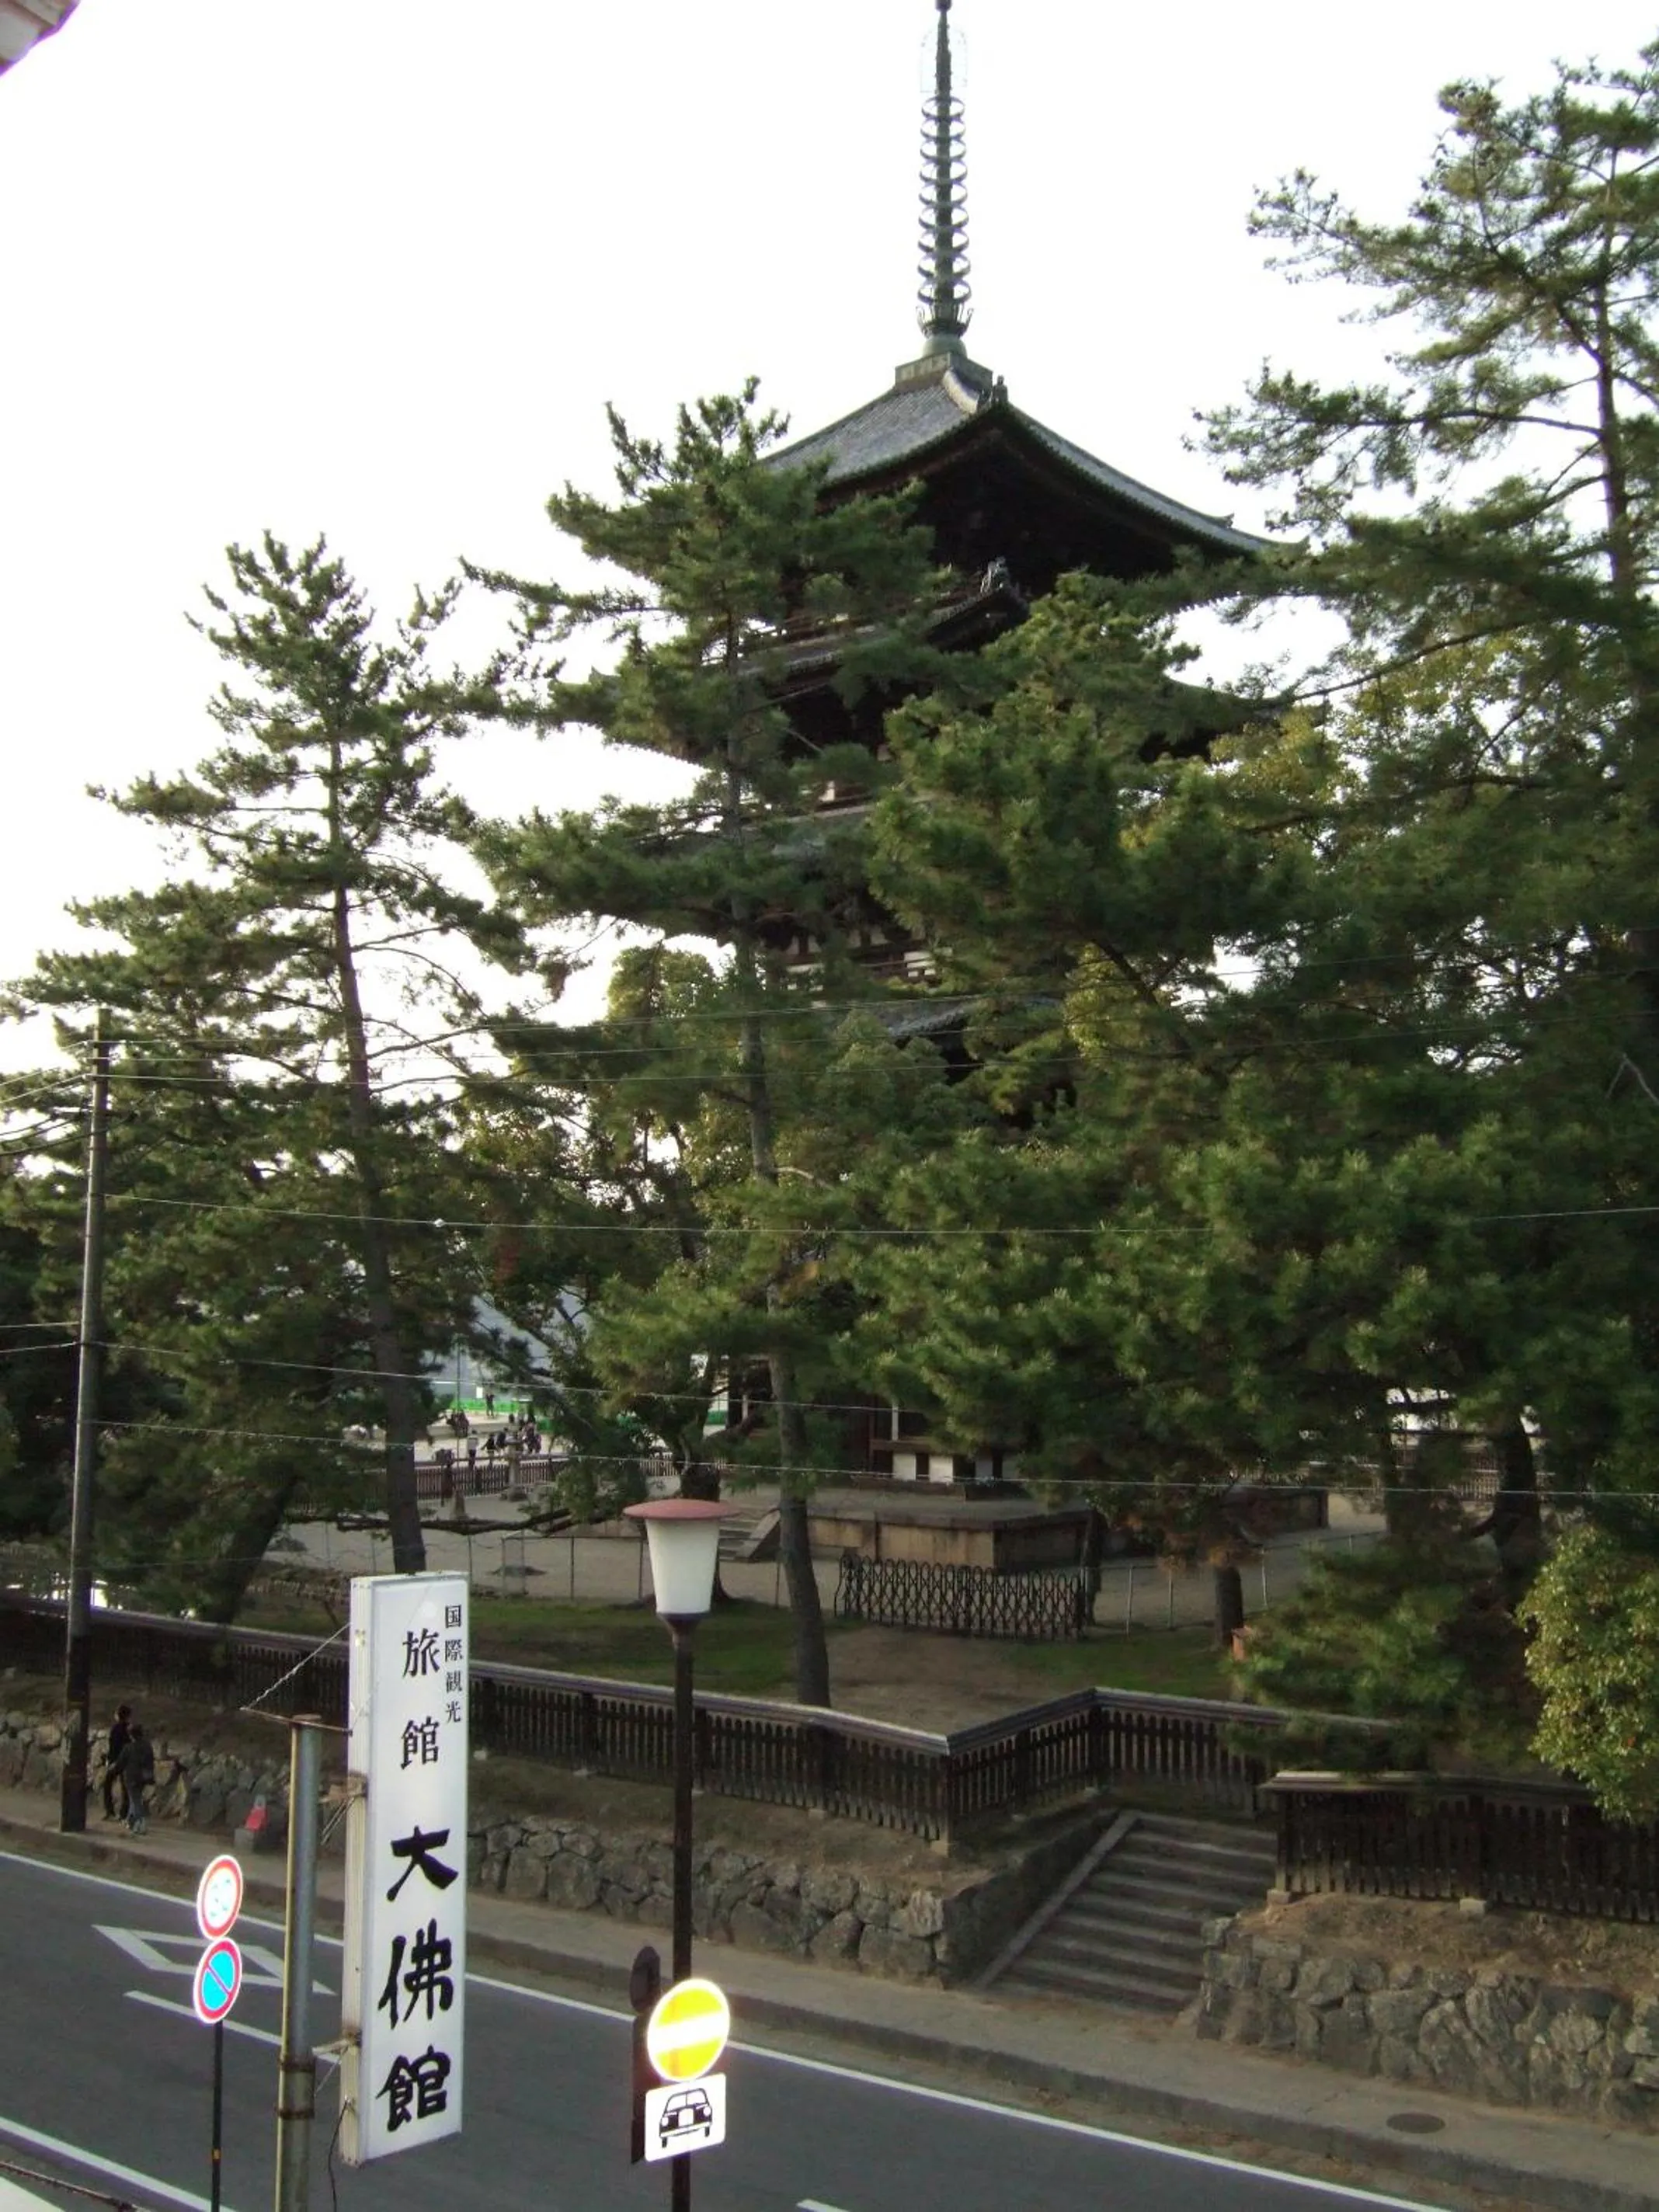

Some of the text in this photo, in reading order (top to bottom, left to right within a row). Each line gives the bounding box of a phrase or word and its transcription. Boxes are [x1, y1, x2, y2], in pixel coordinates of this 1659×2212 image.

[400, 1628, 440, 1770] 旅館
[444, 1604, 463, 1723] 国際観光
[376, 1825, 458, 2132] 大佛館
